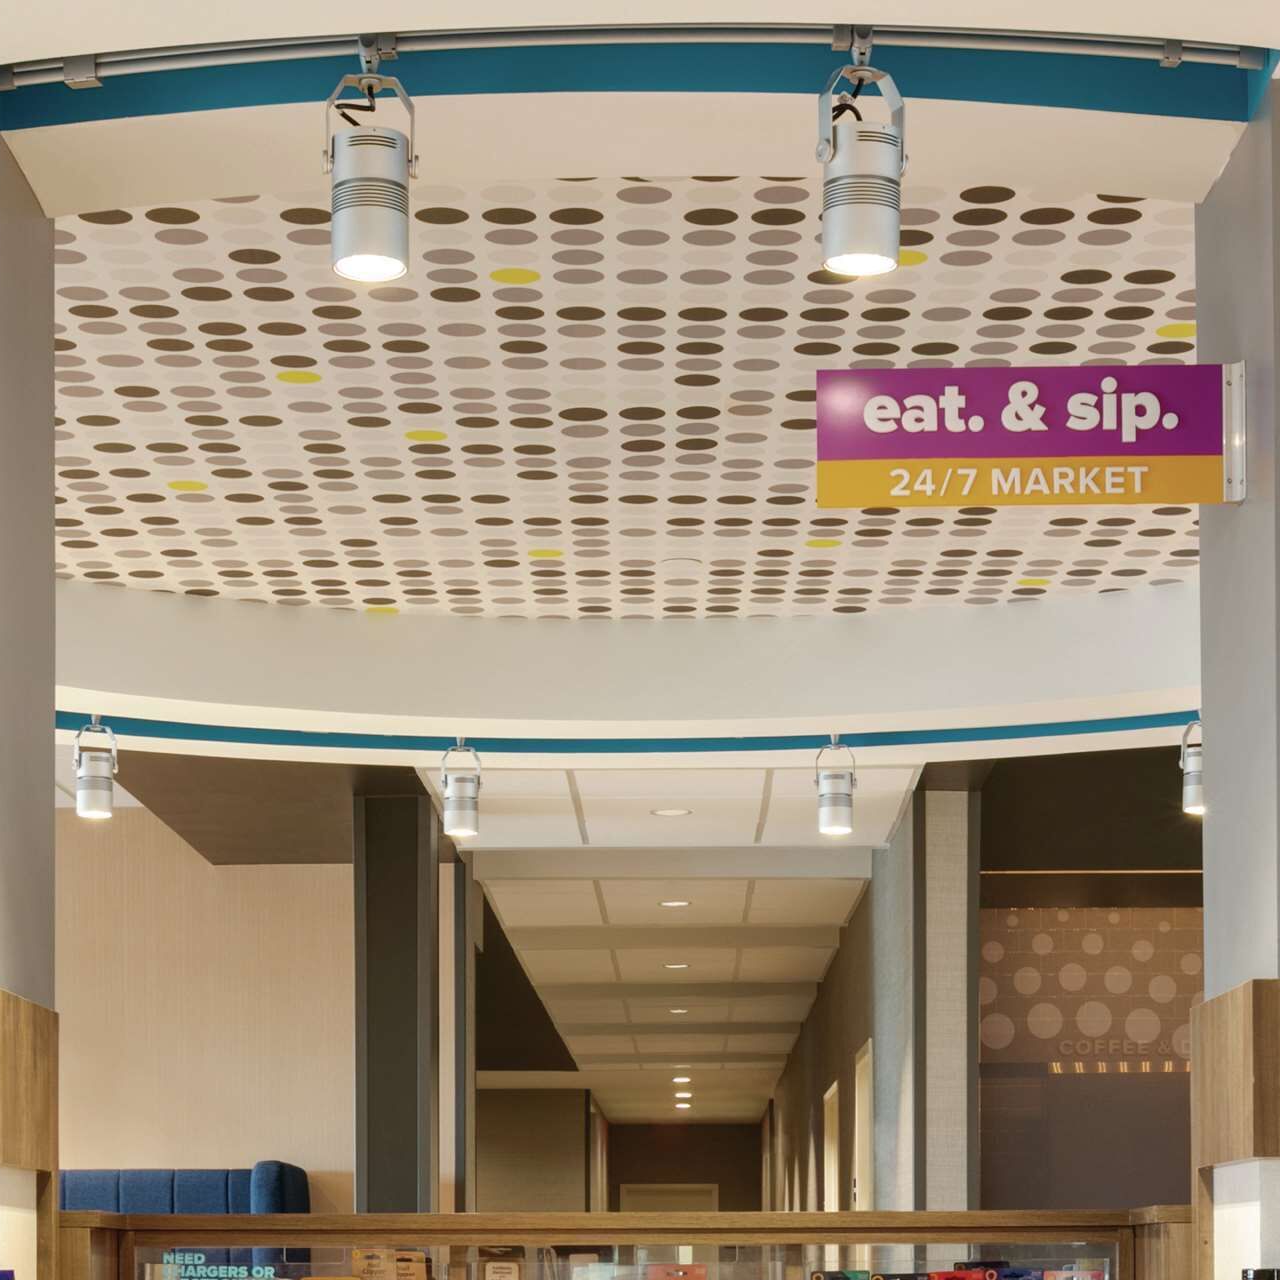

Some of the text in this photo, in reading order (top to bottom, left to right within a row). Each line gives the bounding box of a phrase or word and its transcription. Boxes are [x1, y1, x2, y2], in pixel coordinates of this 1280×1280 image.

[863, 376, 1179, 443] eat. & sip.
[889, 466, 1149, 498] 24/7 MARKET
[1059, 1039, 1172, 1055] COFFEE &
[162, 1253, 206, 1265] NEED
[162, 1266, 275, 1278] CHARGERS OR
